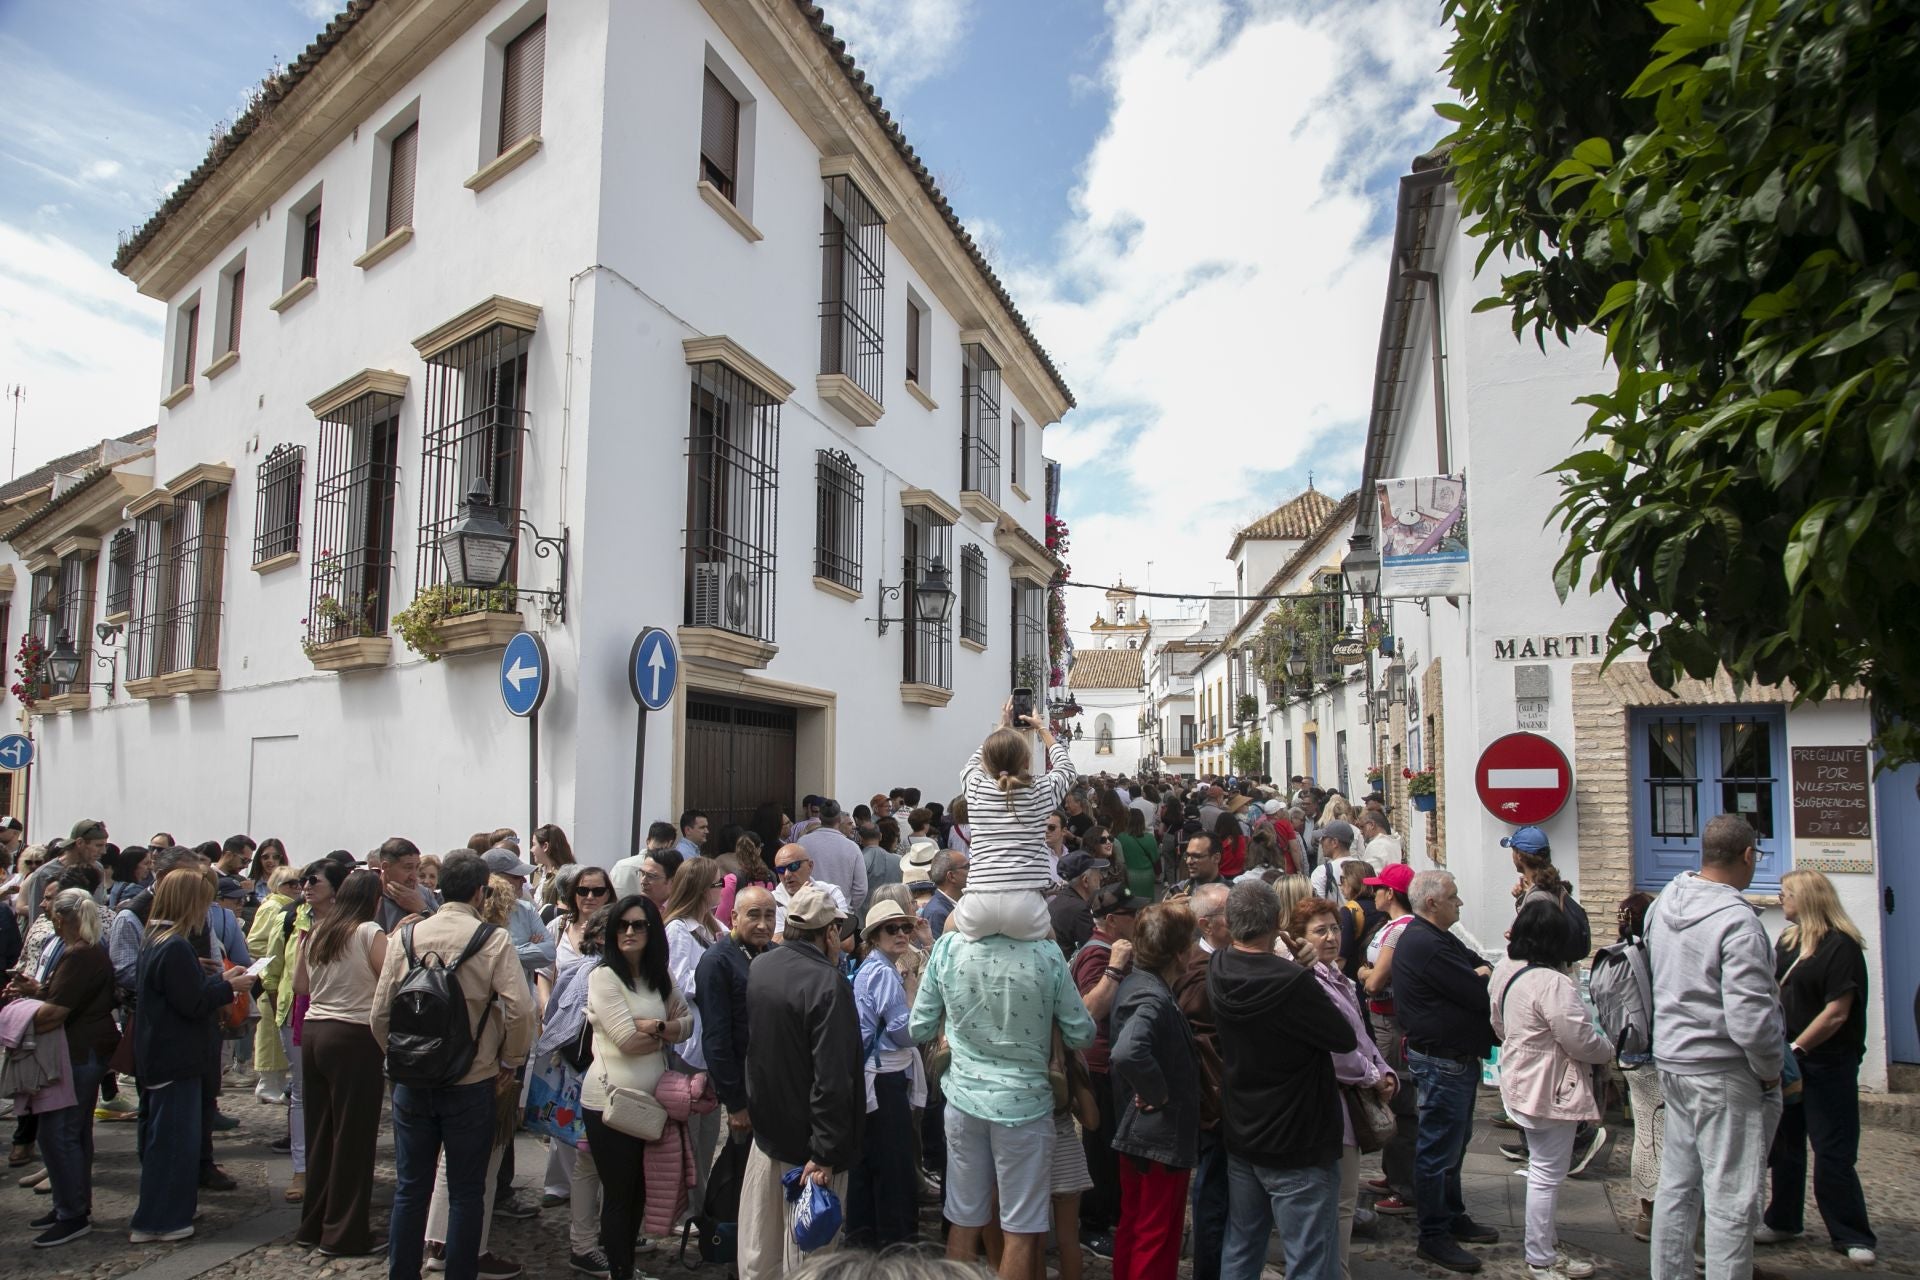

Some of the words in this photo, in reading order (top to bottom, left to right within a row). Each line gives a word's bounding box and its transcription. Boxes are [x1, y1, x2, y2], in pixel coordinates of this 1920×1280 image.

[1793, 749, 1864, 762] PREGUNTE
[1817, 766, 1849, 779] POR
[1795, 781, 1865, 792] NUESTRAS
[1793, 797, 1866, 809] SUGERENCIAS
